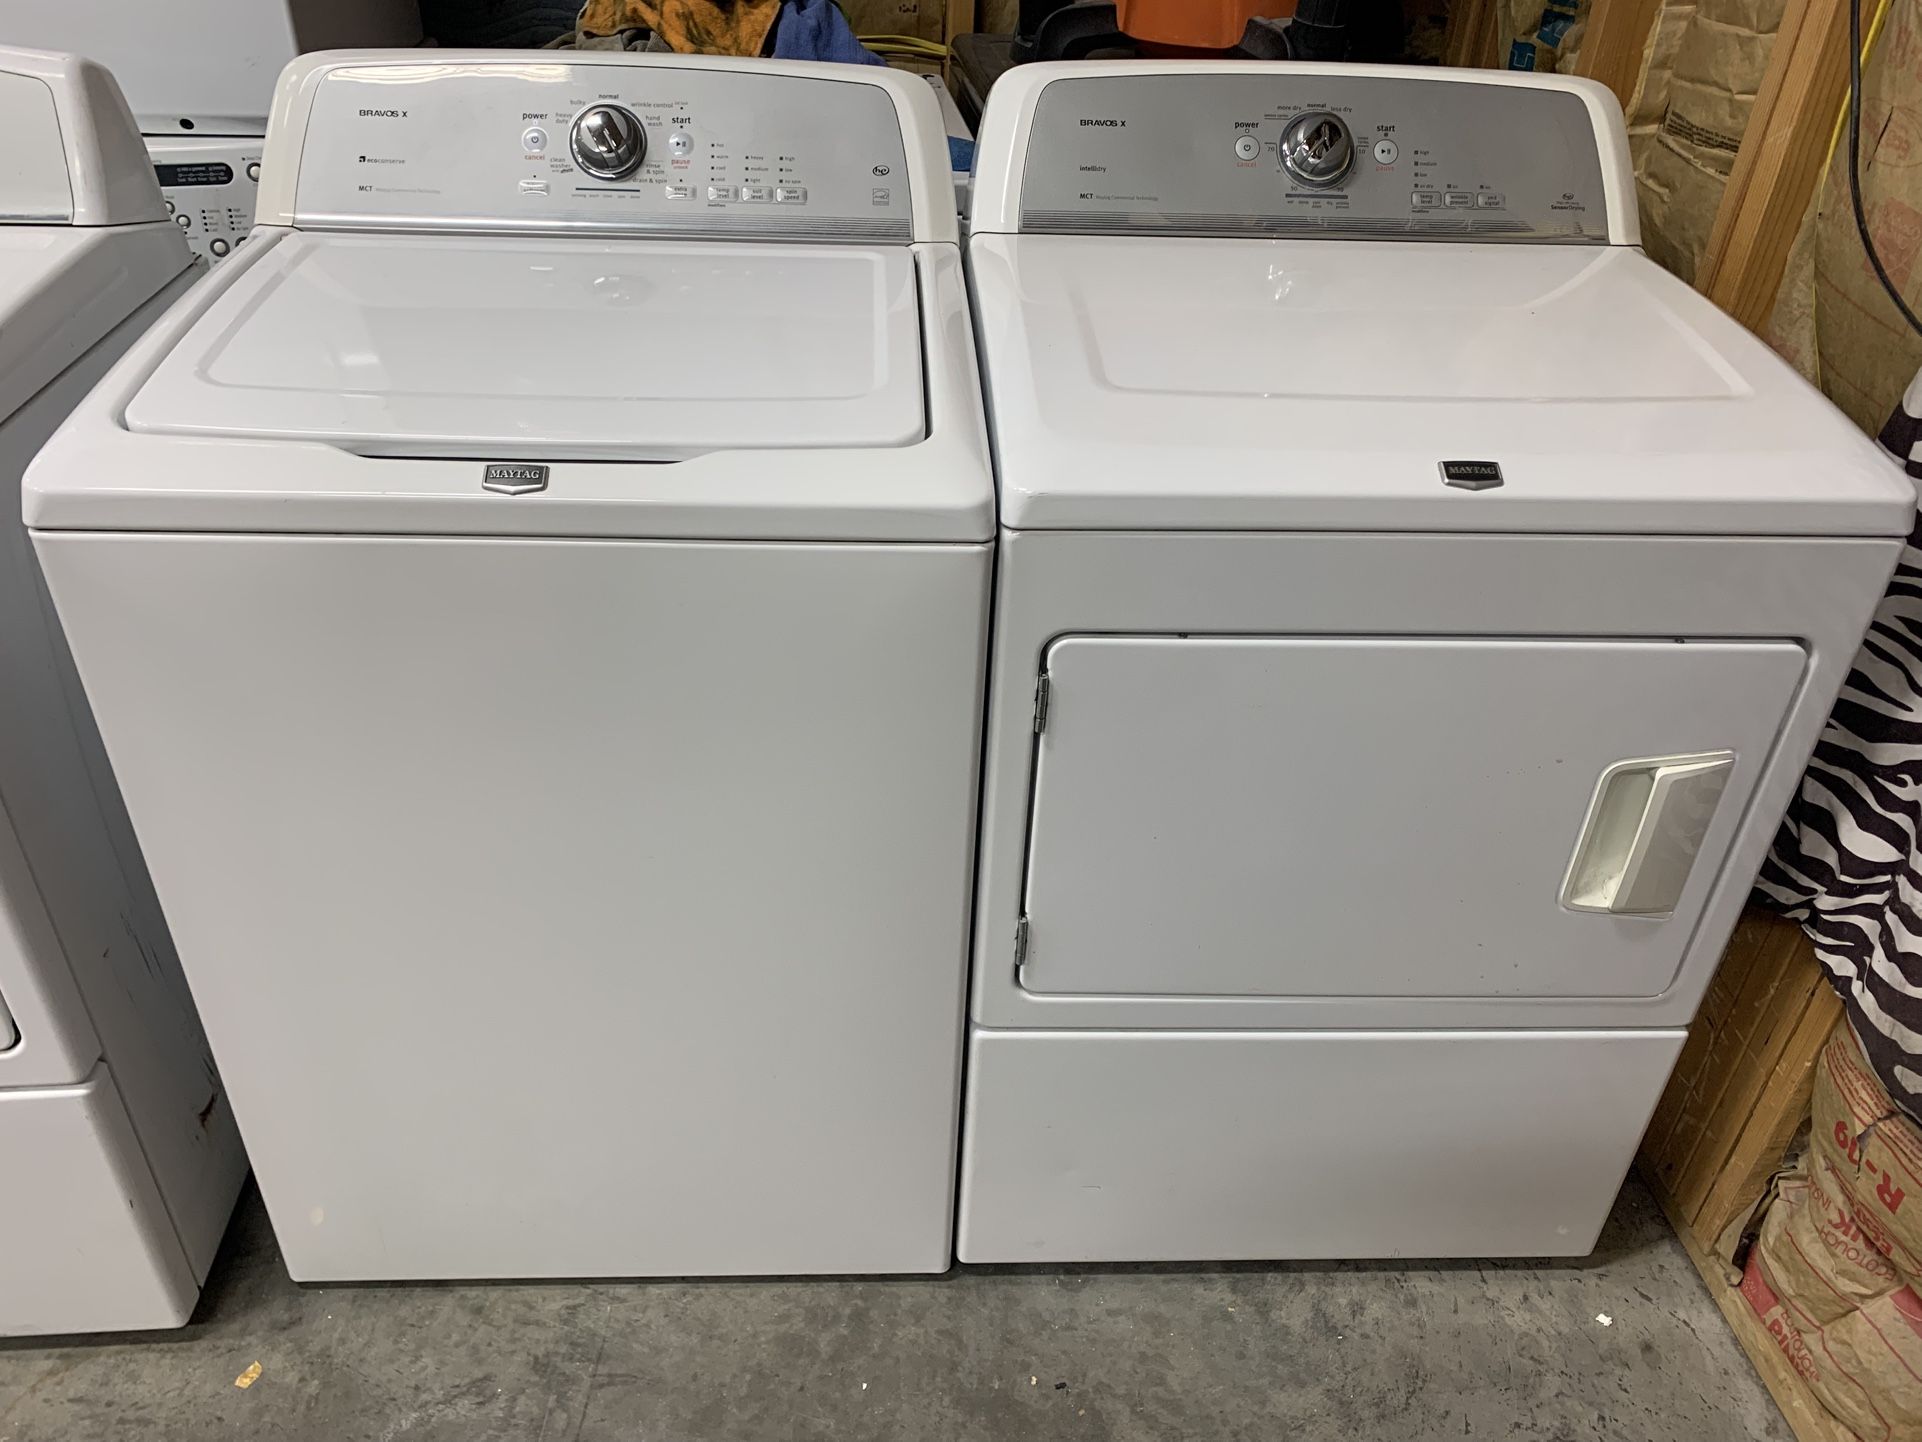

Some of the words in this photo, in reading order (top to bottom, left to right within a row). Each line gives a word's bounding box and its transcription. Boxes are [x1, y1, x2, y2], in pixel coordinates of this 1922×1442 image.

[359, 110, 398, 118] BRAVOS
[672, 116, 691, 124] start
[1376, 124, 1396, 132] start
[490, 470, 540, 478] MAYTAG
[1820, 1225, 1896, 1282] ECOTOUCH
